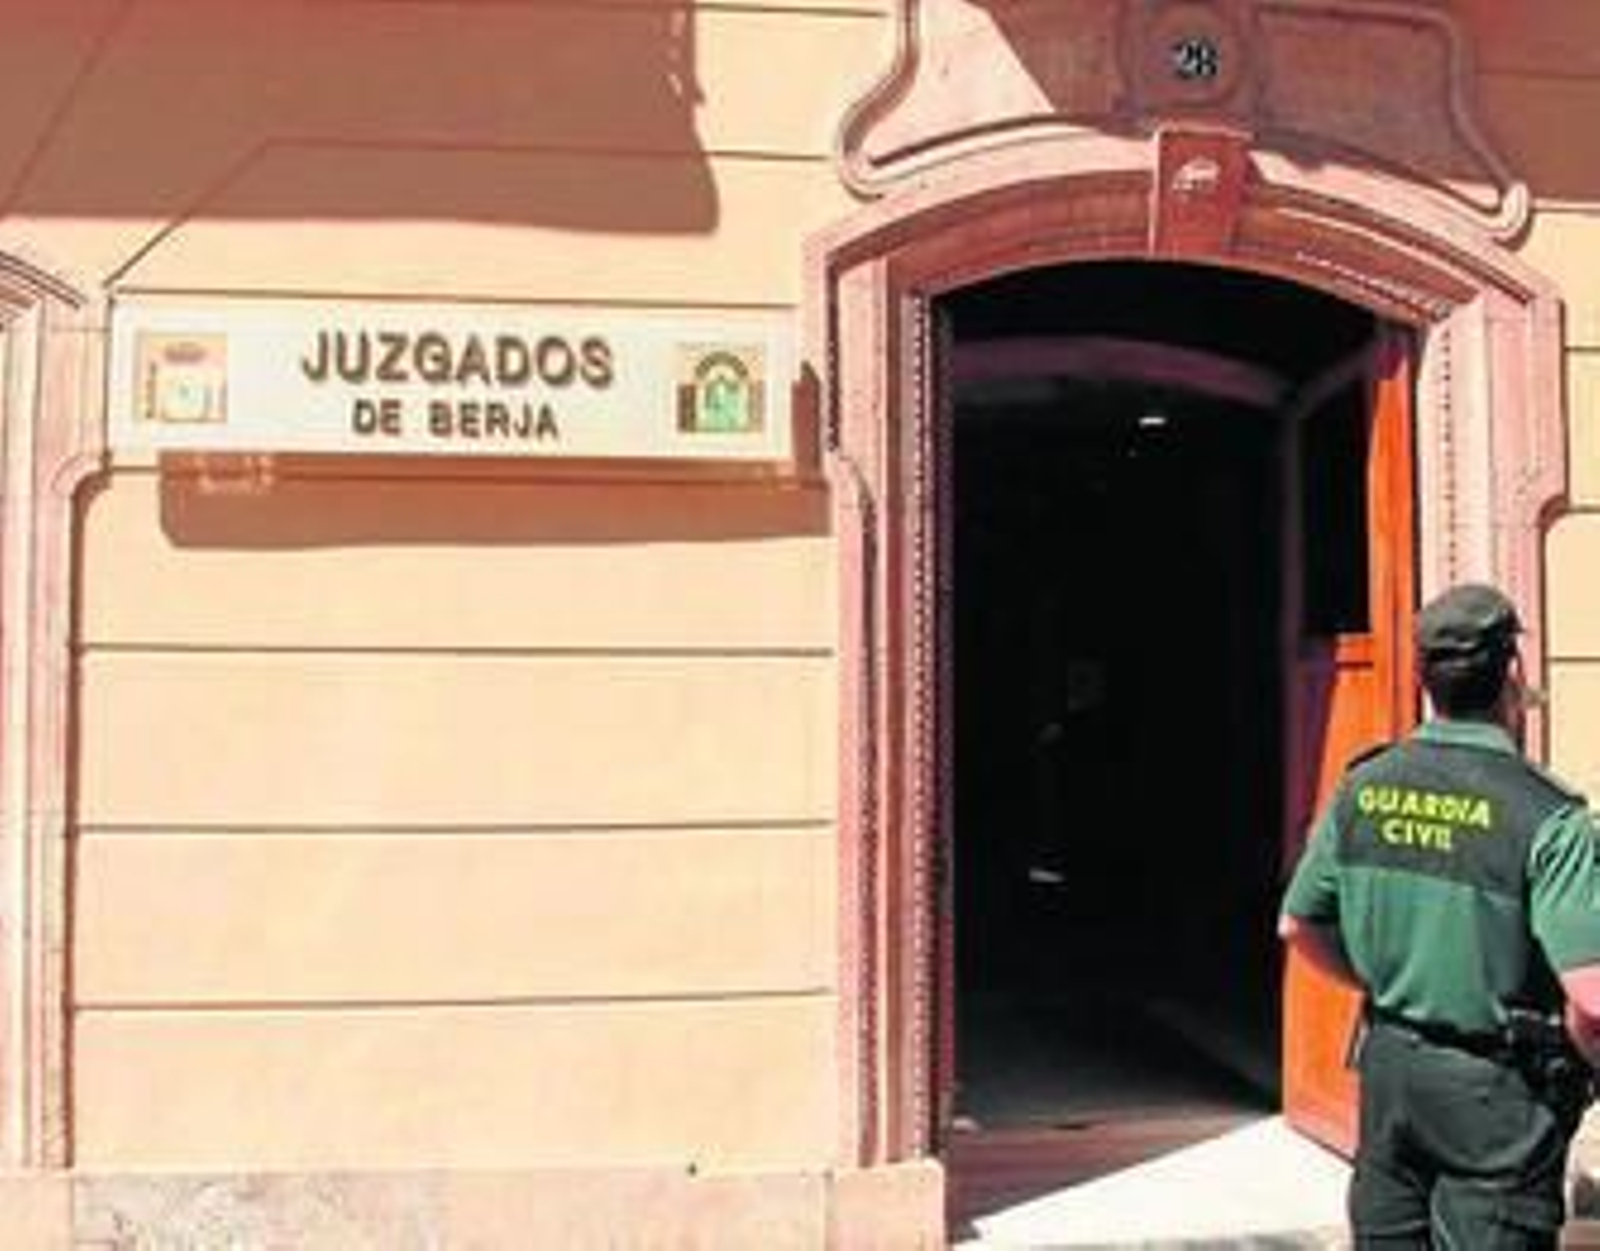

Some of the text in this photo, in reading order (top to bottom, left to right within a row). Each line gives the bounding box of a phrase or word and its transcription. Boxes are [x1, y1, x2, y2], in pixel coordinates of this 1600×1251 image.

[301, 330, 614, 388] JUZGADOS
[352, 400, 558, 439] DE BERJA
[1358, 785, 1490, 828] GUARDIA
[1381, 818, 1451, 850] CIVIL
